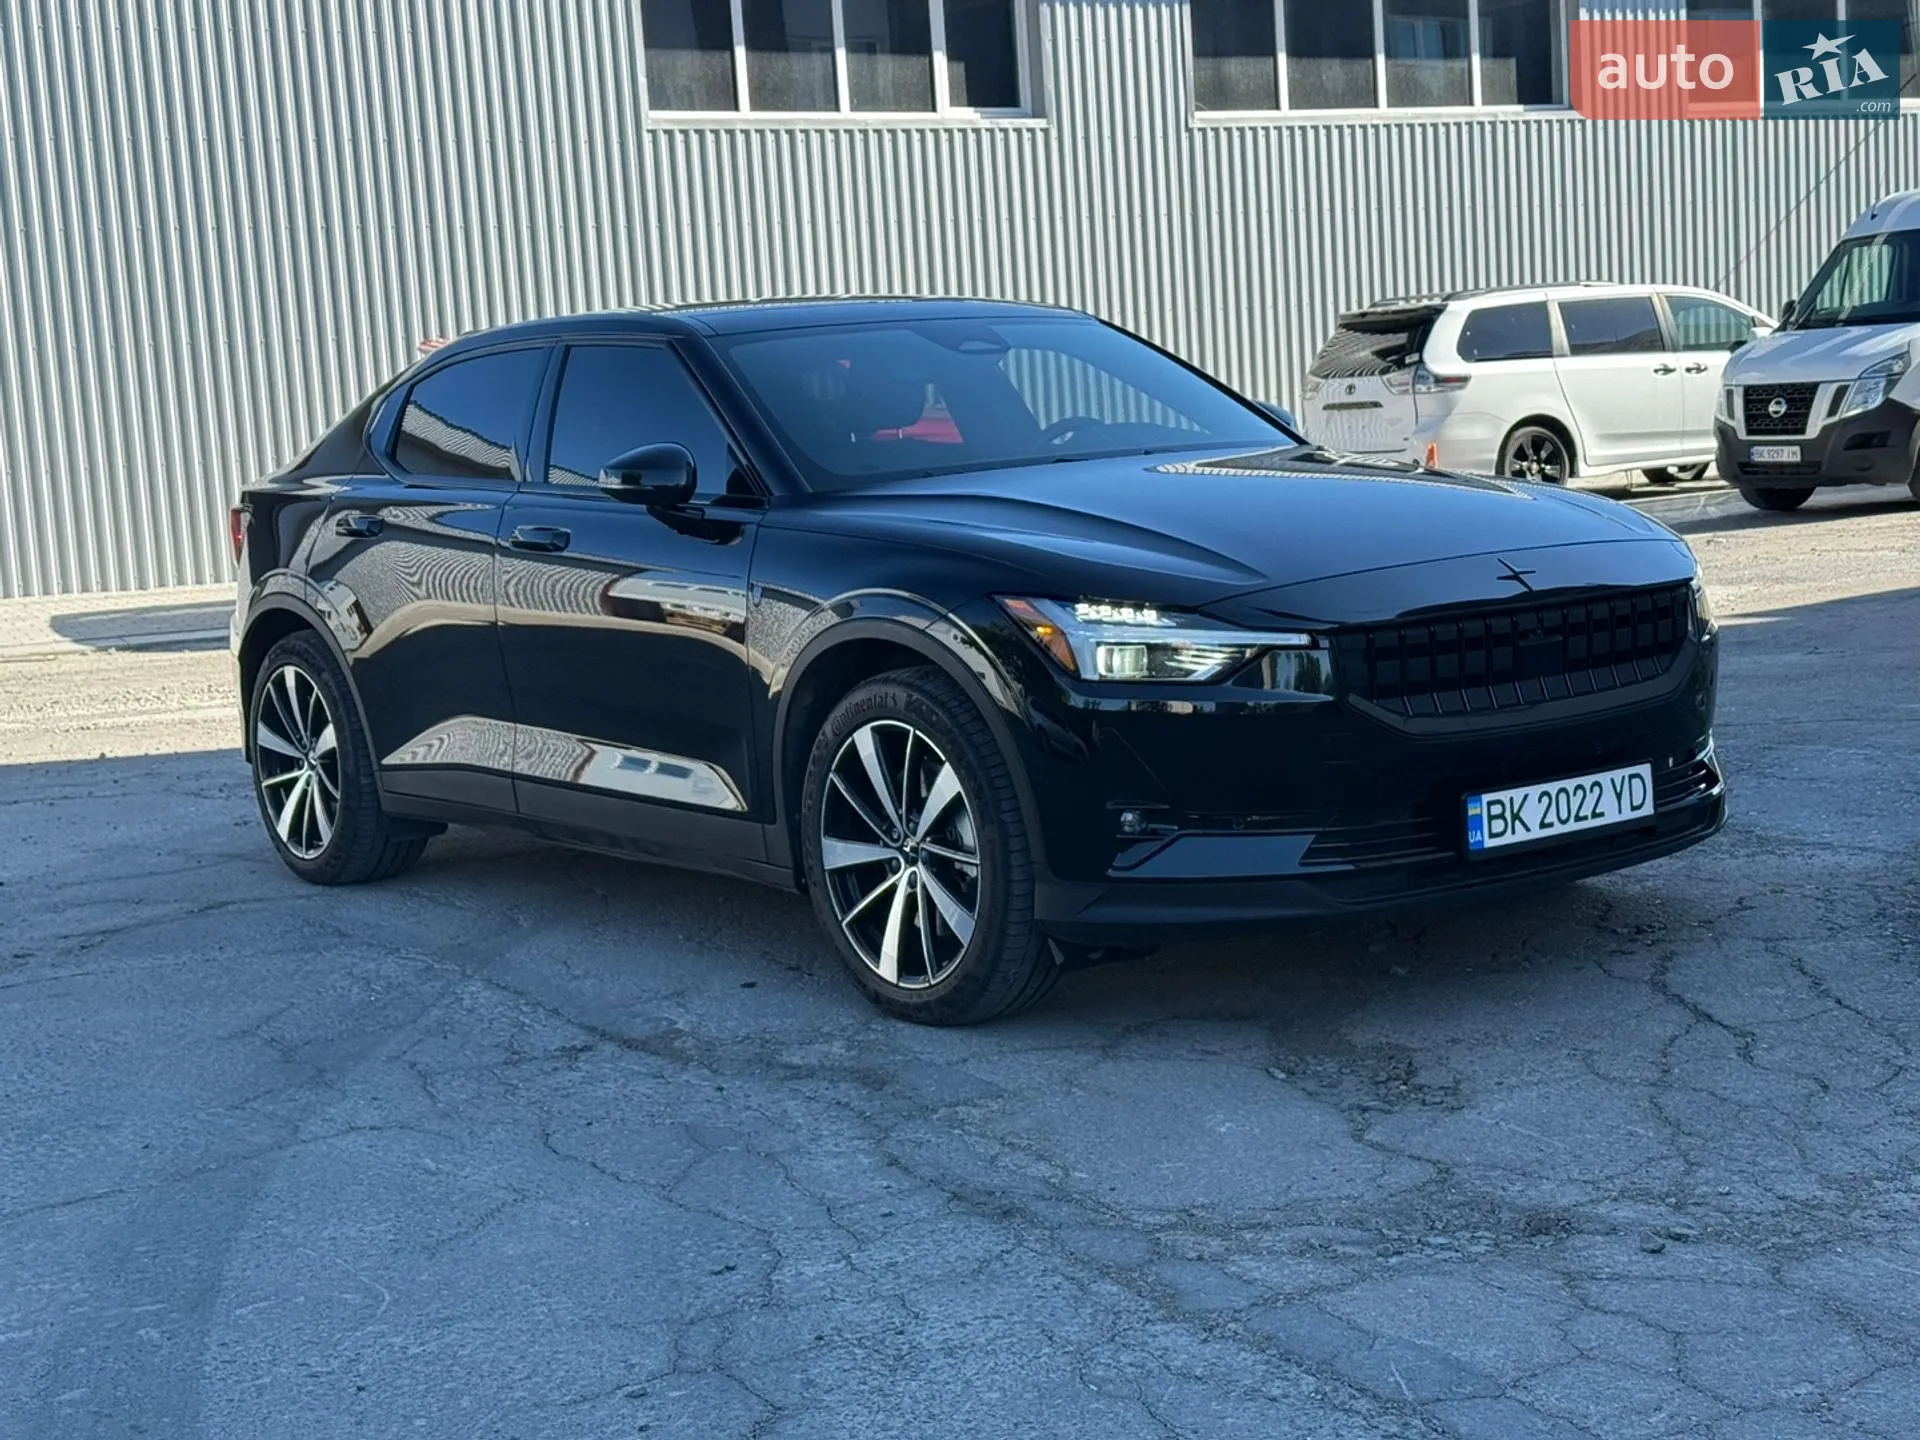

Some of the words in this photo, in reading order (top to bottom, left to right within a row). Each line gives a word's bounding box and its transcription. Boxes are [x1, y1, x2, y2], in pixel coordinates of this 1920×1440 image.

[831, 691, 888, 736] Continental
[1486, 793, 1531, 839] BK
[1537, 780, 1605, 830] 2022
[1610, 773, 1647, 815] YD
[1468, 830, 1482, 843] UA
